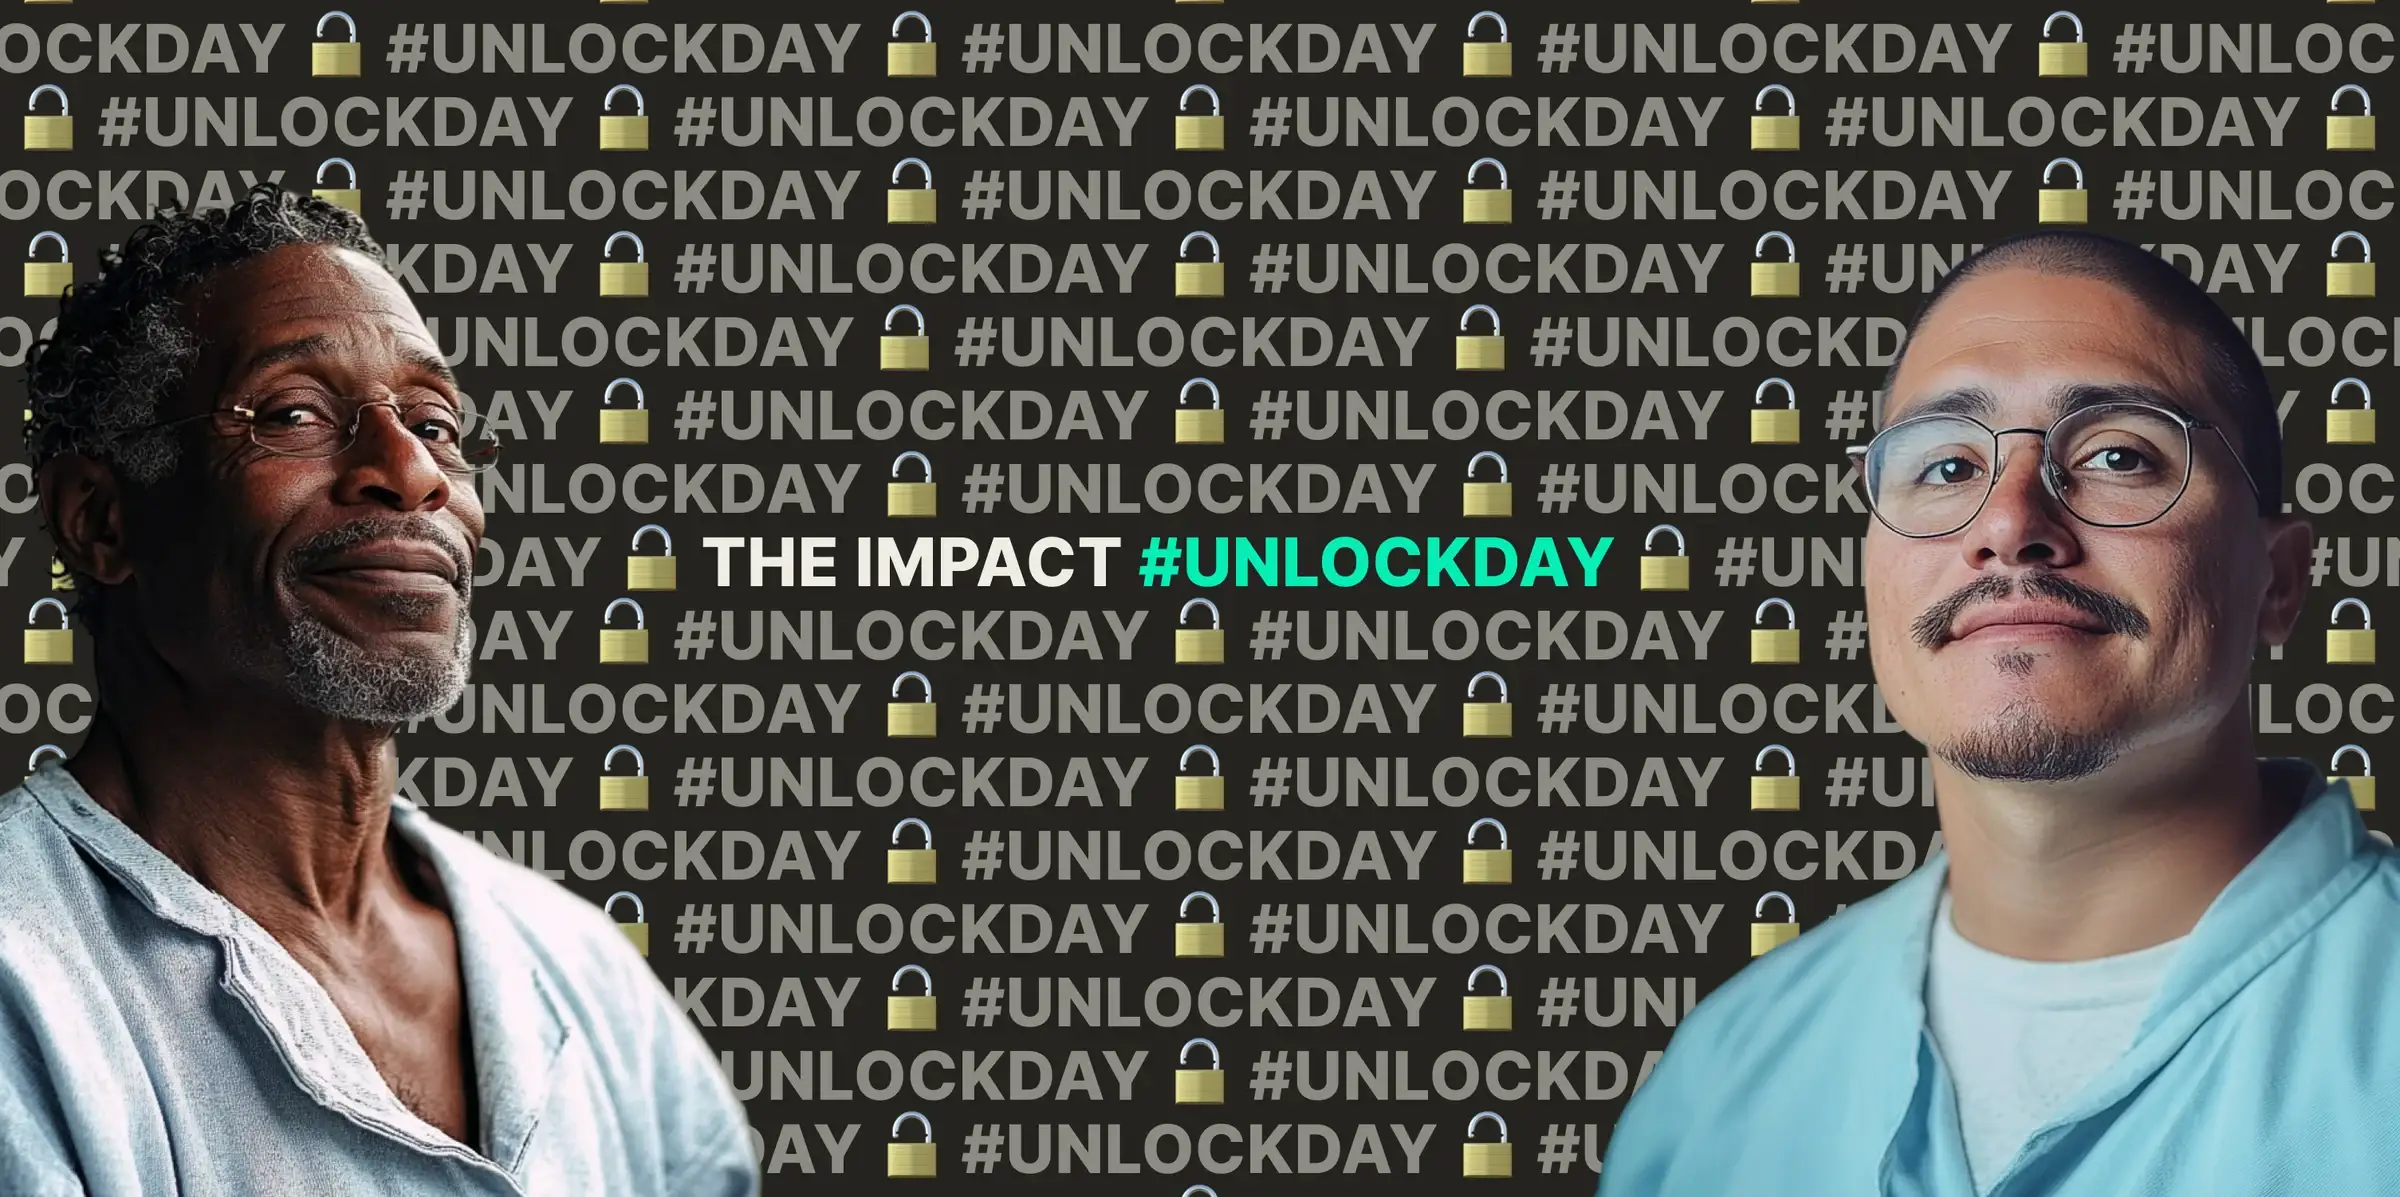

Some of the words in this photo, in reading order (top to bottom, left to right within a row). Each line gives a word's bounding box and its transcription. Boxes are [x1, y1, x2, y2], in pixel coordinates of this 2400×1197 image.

[387, 24, 862, 73] #UNLOCKDAY
[962, 24, 1437, 73] #UNLOCKDAY
[1537, 24, 2012, 73] #UNLOCKDAY
[2113, 24, 2395, 73] #UNLOC
[99, 97, 574, 147] #UNLOCKDAY
[674, 97, 1149, 147] #UNLOCKDAY
[1250, 97, 1725, 147] #UNLOCKDAY
[1825, 97, 2300, 147] #UNLOCKDAY
[387, 170, 862, 220] #UNLOCKDAY
[962, 170, 1437, 220] #UNLOCKDAY
[1538, 170, 2013, 220] #UNLOCKDAY
[2113, 170, 2395, 220] #UNLOC
[674, 244, 1149, 294] #UNLOCKDAY
[1250, 244, 1725, 294] #UNLOCKDAY
[955, 317, 1430, 367] #UNLOCKDAY
[674, 390, 1149, 440] #UNLOCKDAY
[1250, 390, 1725, 440] #UNLOCKDAY
[962, 464, 1437, 514] #UNLOCKDAY
[703, 537, 837, 587] THE
[858, 537, 1122, 587] IMPACT
[1139, 537, 1615, 587] #UNLOCKDAY
[674, 610, 1149, 660] #UNLOCKDAY
[1250, 610, 1725, 660] #UNLOCKDAY
[962, 684, 1437, 734] #UNLOCKDAY
[674, 757, 1149, 807] #UNLOCKDAY
[1250, 757, 1725, 807] #UNLOCKDAY
[962, 830, 1437, 880] #UNLOCKDAY
[674, 904, 1149, 954] #UNLOCKDAY
[1250, 904, 1725, 954] #UNLOCKDAY
[962, 977, 1437, 1027] #UNLOCKDAY
[962, 1124, 1437, 1174] #UNLOCKDAY
